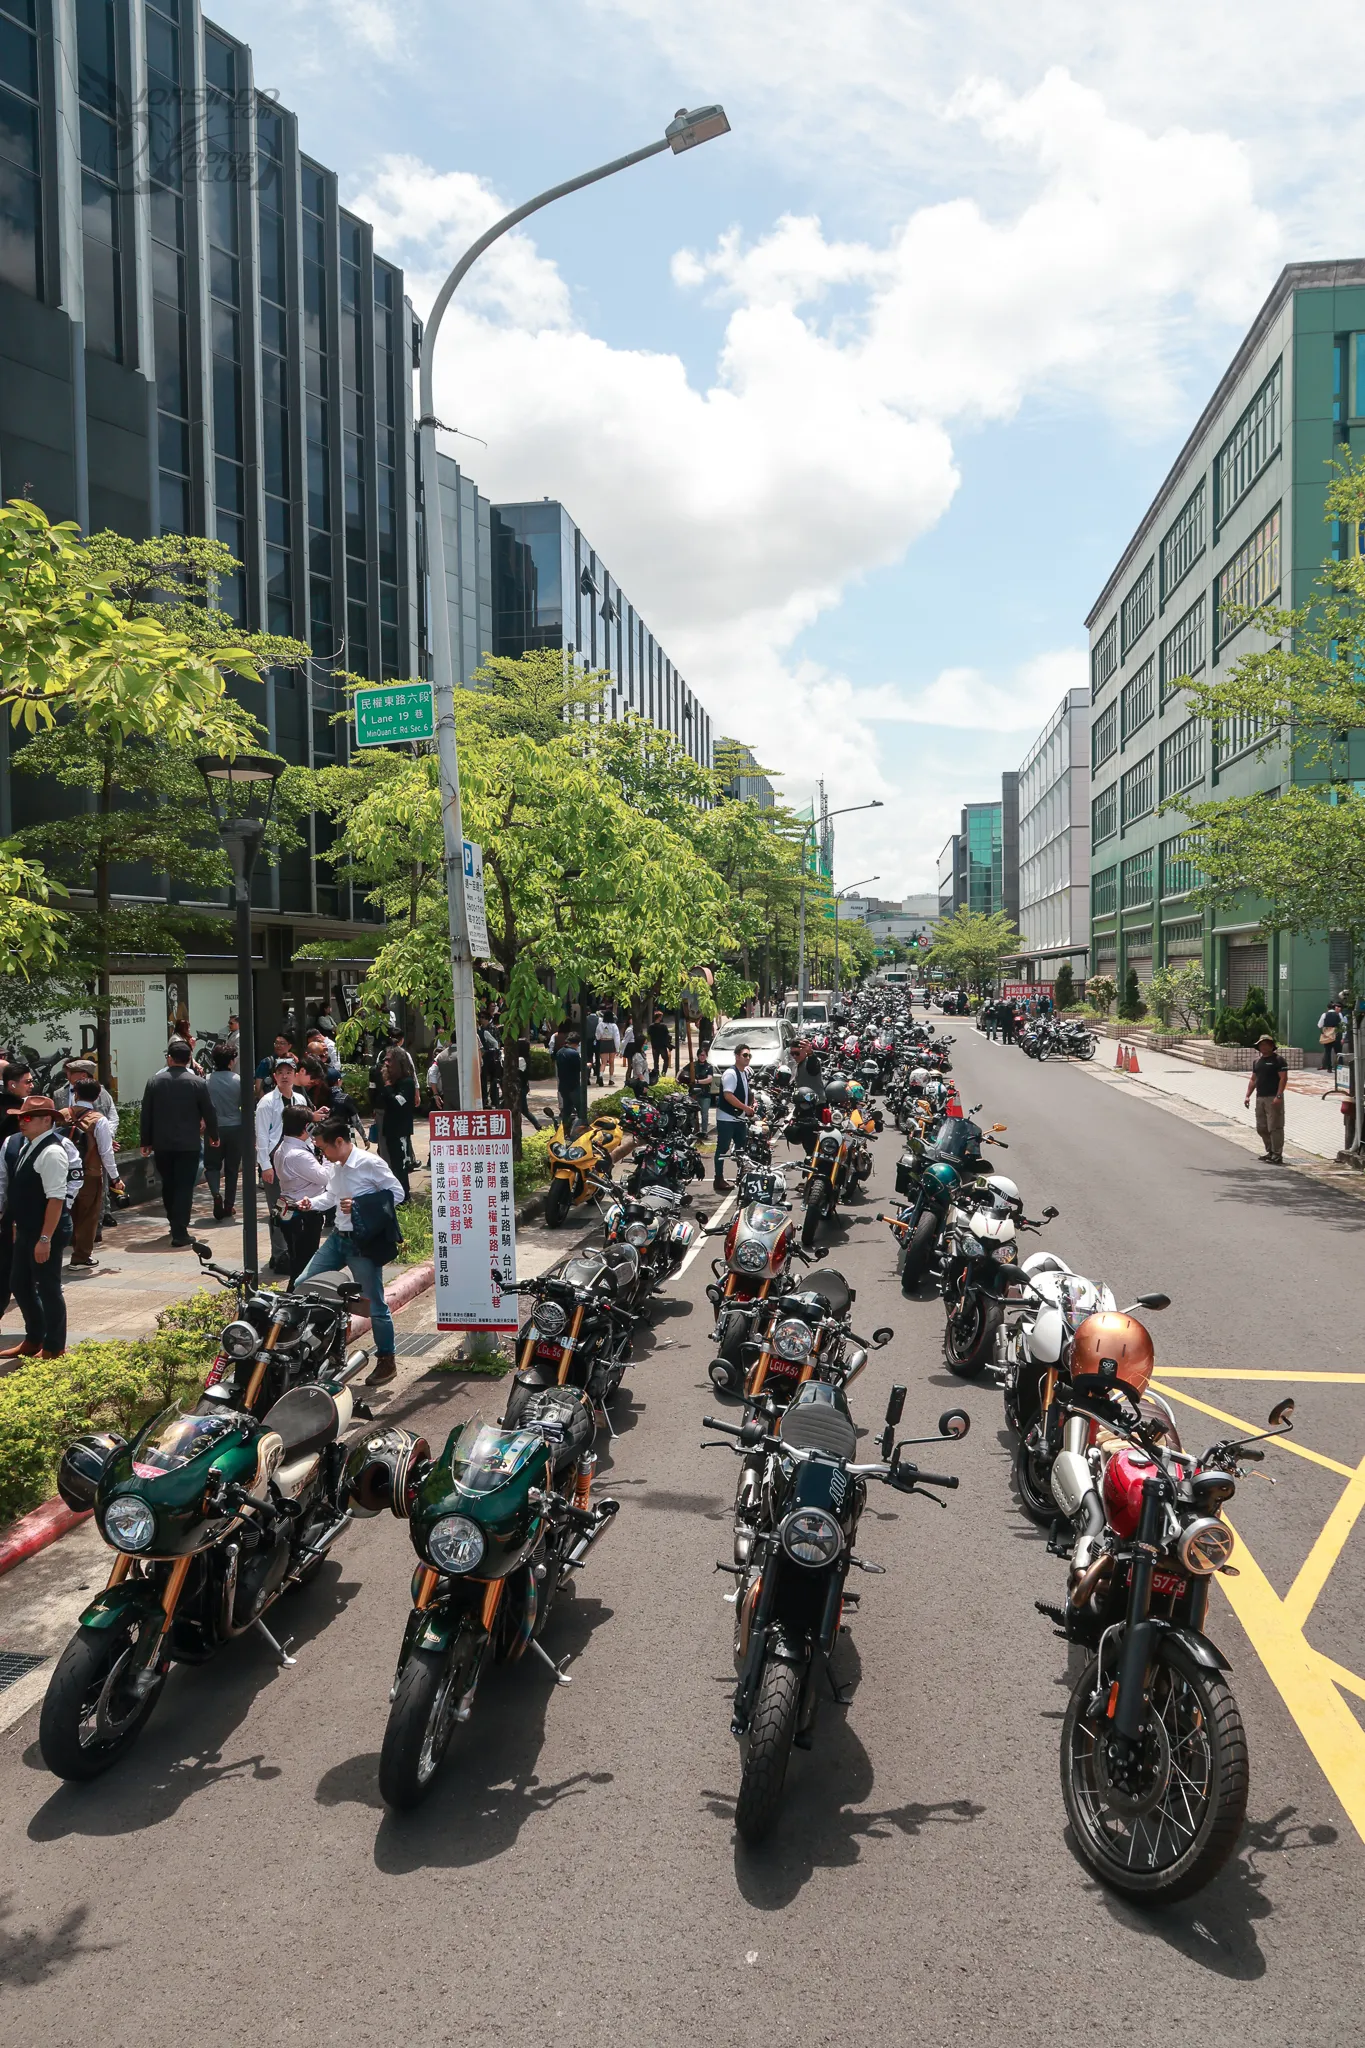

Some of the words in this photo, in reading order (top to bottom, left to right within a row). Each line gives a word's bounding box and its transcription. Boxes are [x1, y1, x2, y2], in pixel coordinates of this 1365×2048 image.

[361, 691, 430, 710] 民權東路六段
[371, 715, 393, 725] Lane
[398, 711, 409, 721] 19
[414, 709, 424, 719] 巷
[423, 723, 429, 731] 6
[464, 847, 472, 871] P
[434, 1114, 506, 1137] 路權活動
[474, 1161, 484, 1189] 部份
[486, 1161, 497, 1189] 封閉
[746, 1179, 764, 1194] 31
[435, 1161, 447, 1218] 造成不便
[460, 1161, 473, 1230] 23號至39號
[447, 1162, 462, 1246] 單向道路封閉
[499, 1161, 511, 1247] 慈善紳士路騎
[438, 1231, 450, 1287] 敬請見諒
[488, 1195, 501, 1309] 民權東路六15巷
[537, 1345, 561, 1358] LGL-36
[1102, 1361, 1115, 1369] DOT
[829, 1467, 847, 1507] 400
